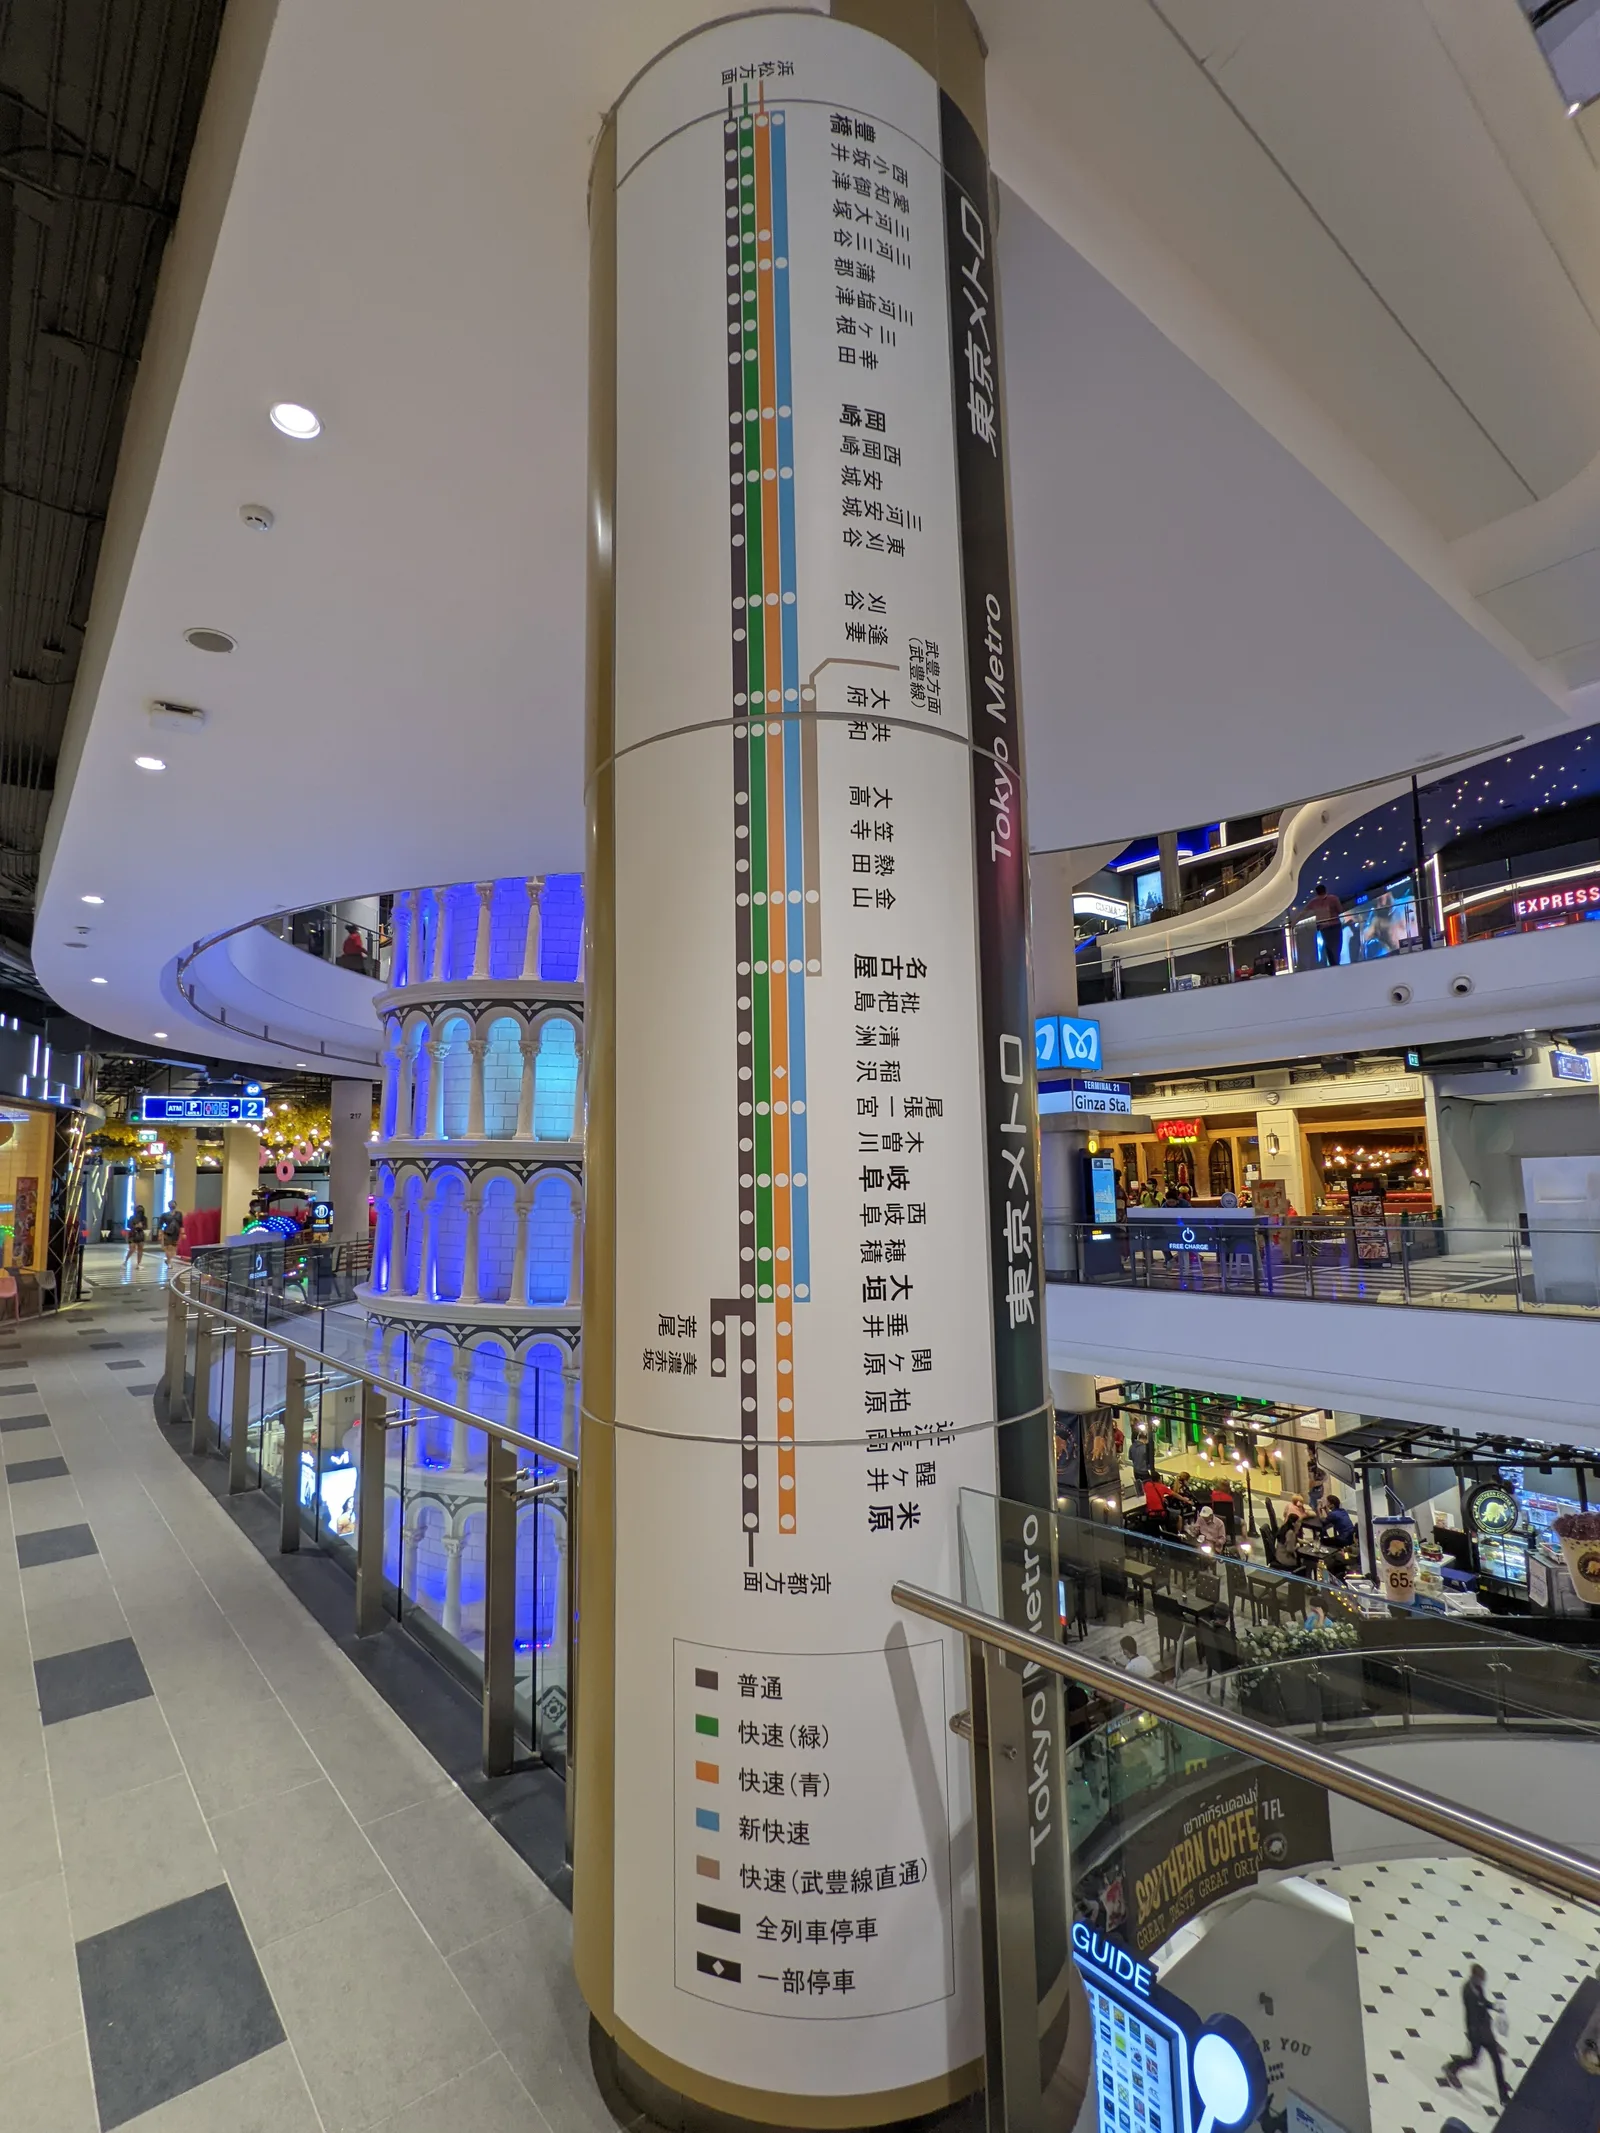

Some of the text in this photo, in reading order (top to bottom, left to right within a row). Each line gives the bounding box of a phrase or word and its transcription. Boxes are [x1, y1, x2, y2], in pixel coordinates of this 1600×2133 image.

[721, 60, 794, 85] 浜松方面
[830, 112, 876, 143] 豊橋
[830, 143, 910, 188] 西小坂井
[832, 170, 910, 214] 愛知御津
[832, 198, 910, 242] 三河大塚
[833, 228, 912, 270] 三河三谷
[834, 256, 876, 283] 蒲郡
[836, 286, 914, 326] 三河塩津
[961, 196, 997, 458] 東京メトロ
[838, 346, 878, 370] 幸田
[839, 403, 886, 433] 岡崎
[840, 434, 901, 466] 西岡崎
[841, 464, 884, 490] 安城
[842, 496, 922, 532] 三河安城
[842, 527, 906, 556] 東刈谷
[844, 590, 886, 614] 刈谷
[845, 621, 888, 646] 逢妻
[924, 639, 942, 716] 武豊方面
[847, 685, 890, 710] 大府
[847, 720, 892, 743] 共和
[985, 593, 1013, 862] Tokyo Metro
[848, 786, 893, 809] 大高
[850, 820, 894, 842] 笠寺
[852, 853, 895, 877] 熱田
[853, 887, 896, 910] 金山
[1517, 886, 1600, 915] EXPRESS
[853, 953, 928, 980] 名古屋
[854, 990, 920, 1014] 枇杷島
[855, 1024, 900, 1048] 清洲
[856, 1060, 901, 1082] 稲沢
[1084, 1080, 1120, 1092] TERMINAL 21
[190, 1102, 198, 1111] P
[247, 1102, 257, 1116] 2
[857, 1096, 944, 1118] 尾張一宮
[1075, 1095, 1130, 1112] Ginza Sta.
[858, 1131, 924, 1154] 木曽川
[859, 1165, 910, 1192] 岐阜
[1000, 1033, 1034, 1329] 東京メトロ
[860, 1202, 926, 1227] 西岐阜
[860, 1239, 906, 1264] 穂積
[862, 1274, 914, 1302] 大垣
[658, 1313, 697, 1338] 荒尾
[863, 1313, 909, 1338] 垂井
[642, 1348, 698, 1376] 美濃赤坂
[864, 1388, 911, 1414] 柏原
[866, 1420, 955, 1452] 近江長岡
[868, 1501, 921, 1532] 米原
[744, 1572, 832, 1594] 京都方面
[737, 1673, 782, 1700] 普通
[1028, 1691, 1052, 1866] Tokyo
[739, 1814, 810, 1846] 新快速
[1136, 1831, 1206, 1924] SOUTHERN
[1137, 1914, 1166, 1950] GREAT
[1169, 1888, 1195, 1923] TASTE
[1199, 1868, 1229, 1898] GREAT
[756, 1916, 878, 1946] 全列車停車
[1072, 1922, 1151, 1996] GUIDE
[758, 1968, 856, 1996] 一部停車
[1280, 2037, 1312, 2056] YOU
